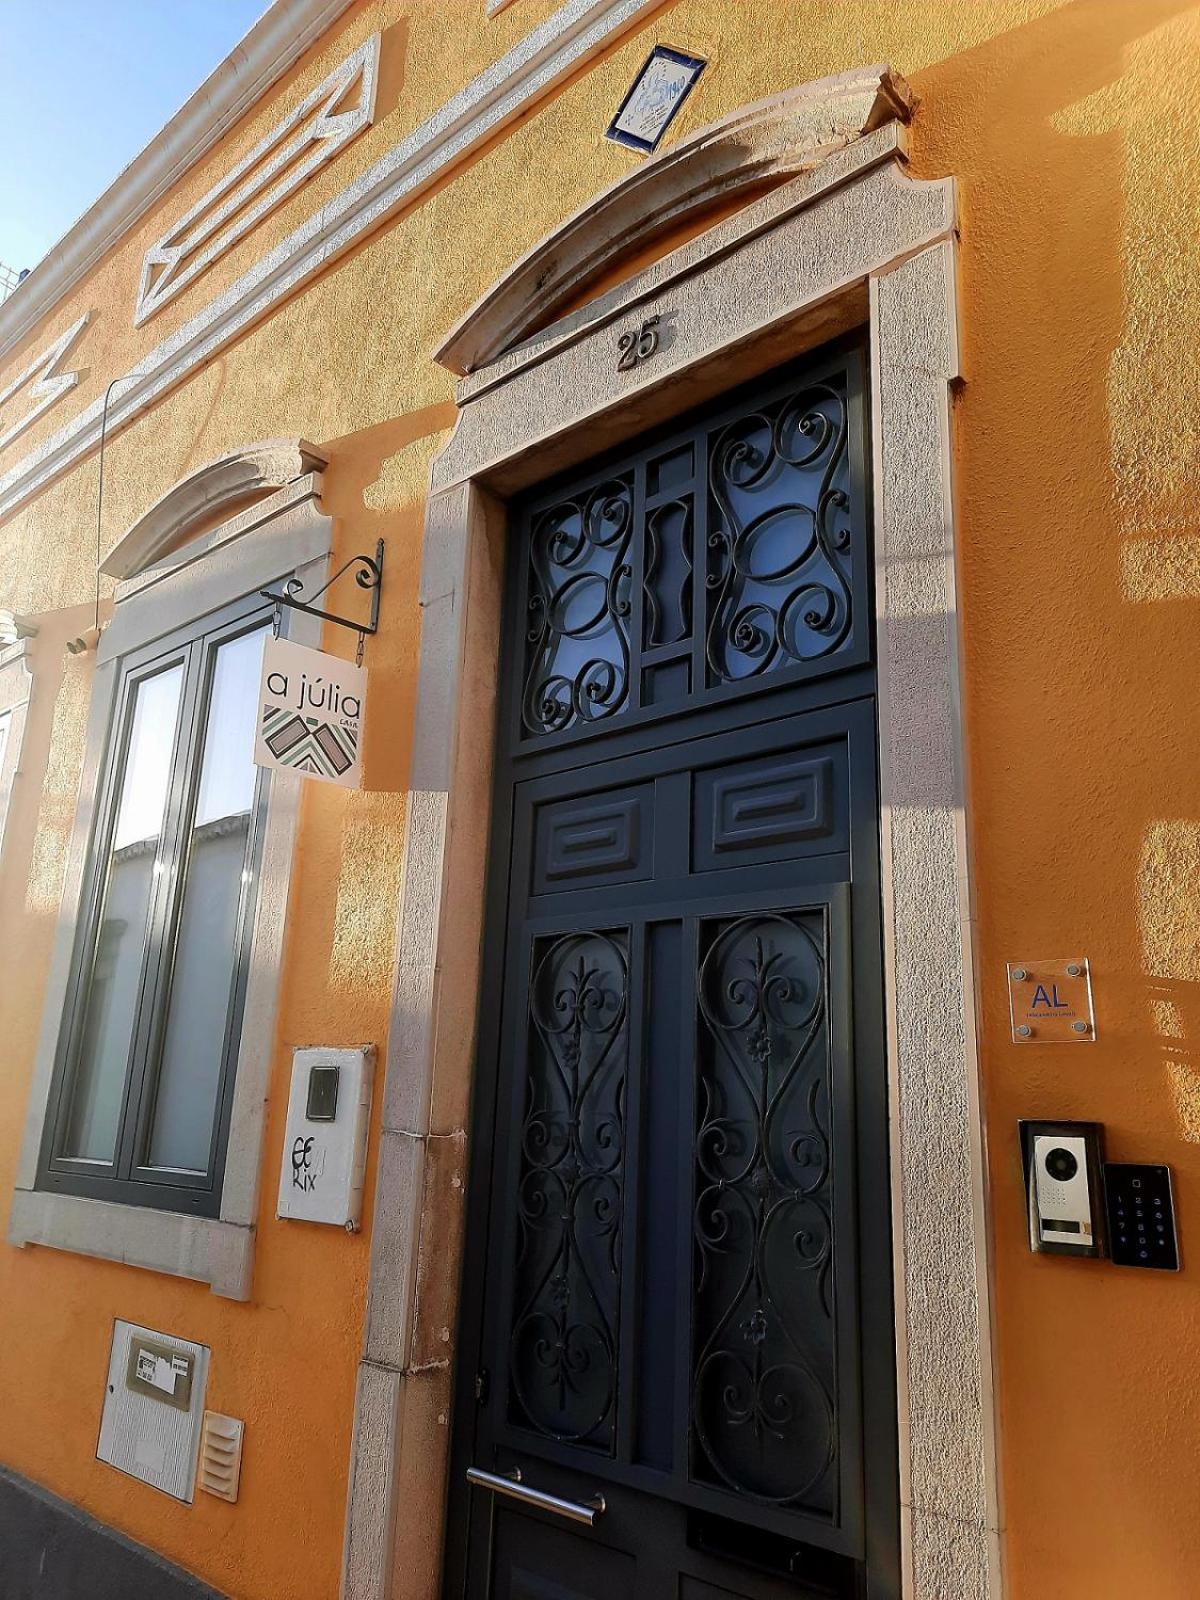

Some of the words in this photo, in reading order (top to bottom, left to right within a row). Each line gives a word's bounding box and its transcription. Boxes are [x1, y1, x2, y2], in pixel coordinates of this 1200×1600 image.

[617, 314, 660, 372] 25
[267, 672, 288, 698] a
[297, 673, 361, 719] júlia
[1031, 984, 1068, 1008] AL
